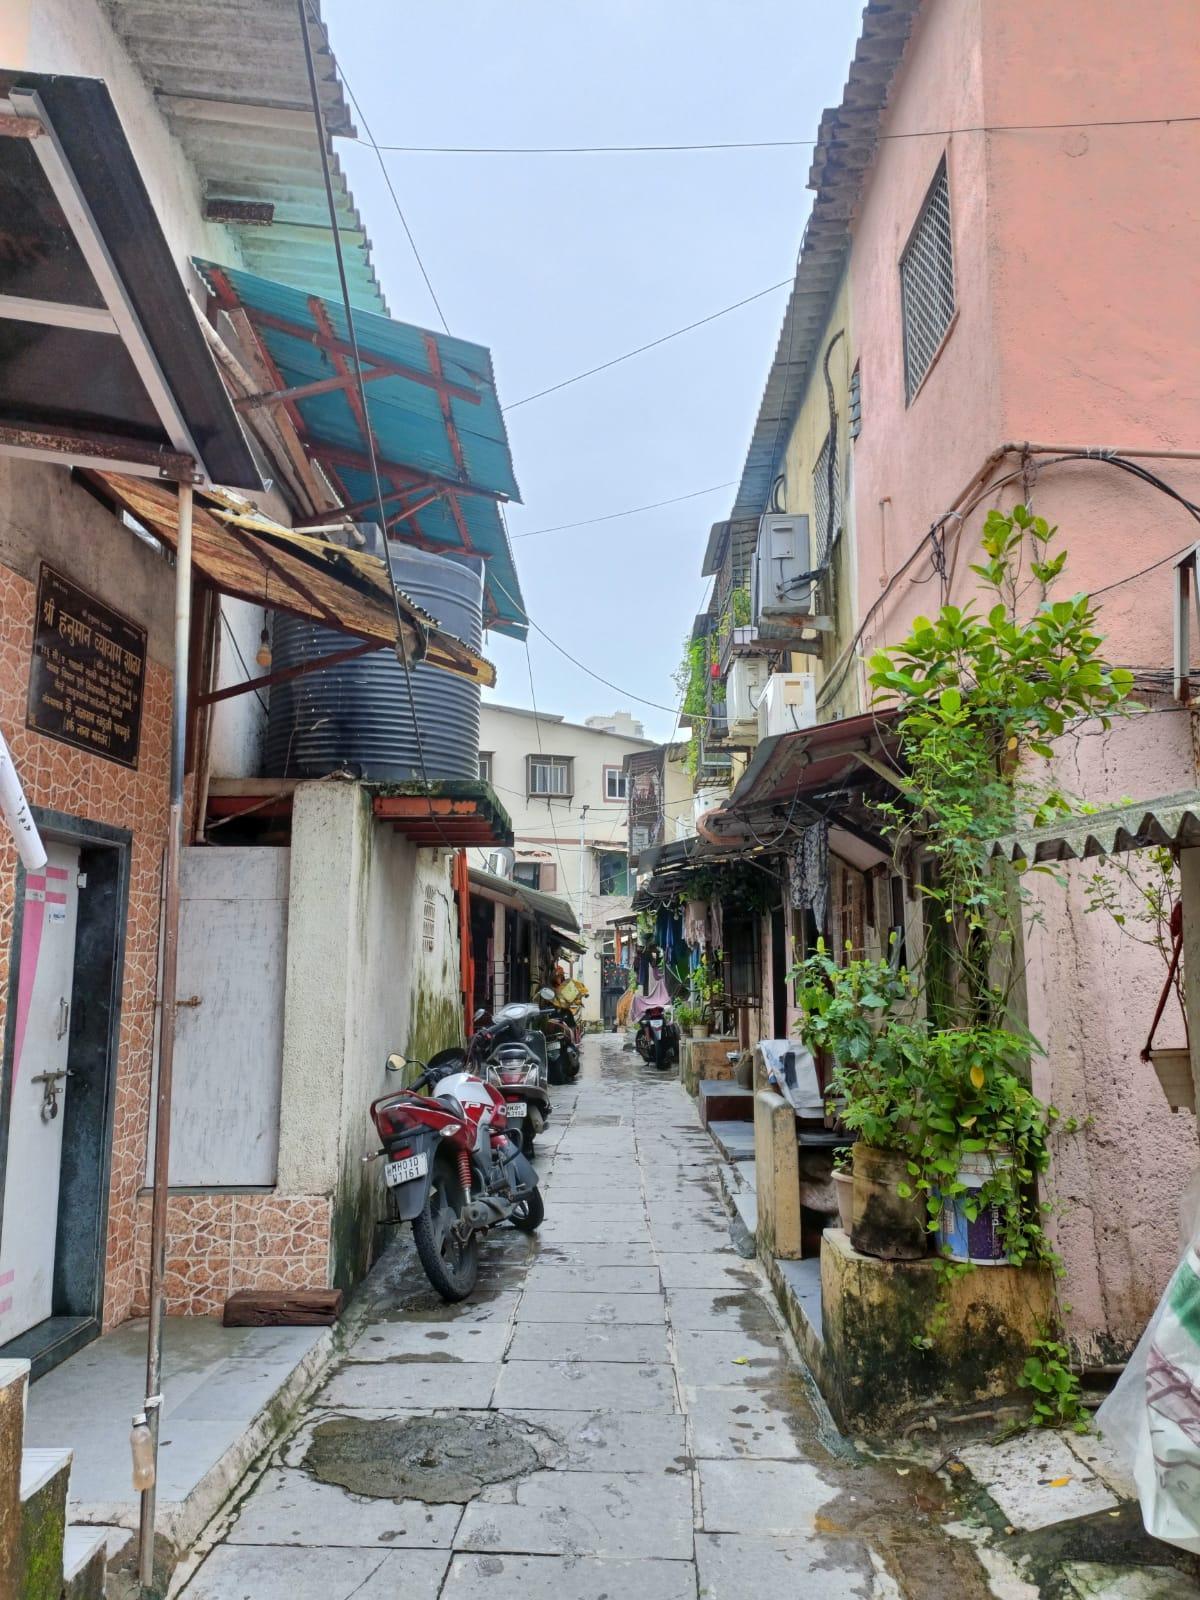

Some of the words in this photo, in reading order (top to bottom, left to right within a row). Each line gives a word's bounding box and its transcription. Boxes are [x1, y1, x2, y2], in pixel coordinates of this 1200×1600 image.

[44, 598, 55, 628] श्री
[59, 609, 92, 648] हनुमान
[95, 632, 122, 665] व्यायाम
[391, 1157, 418, 1172] MH01D
